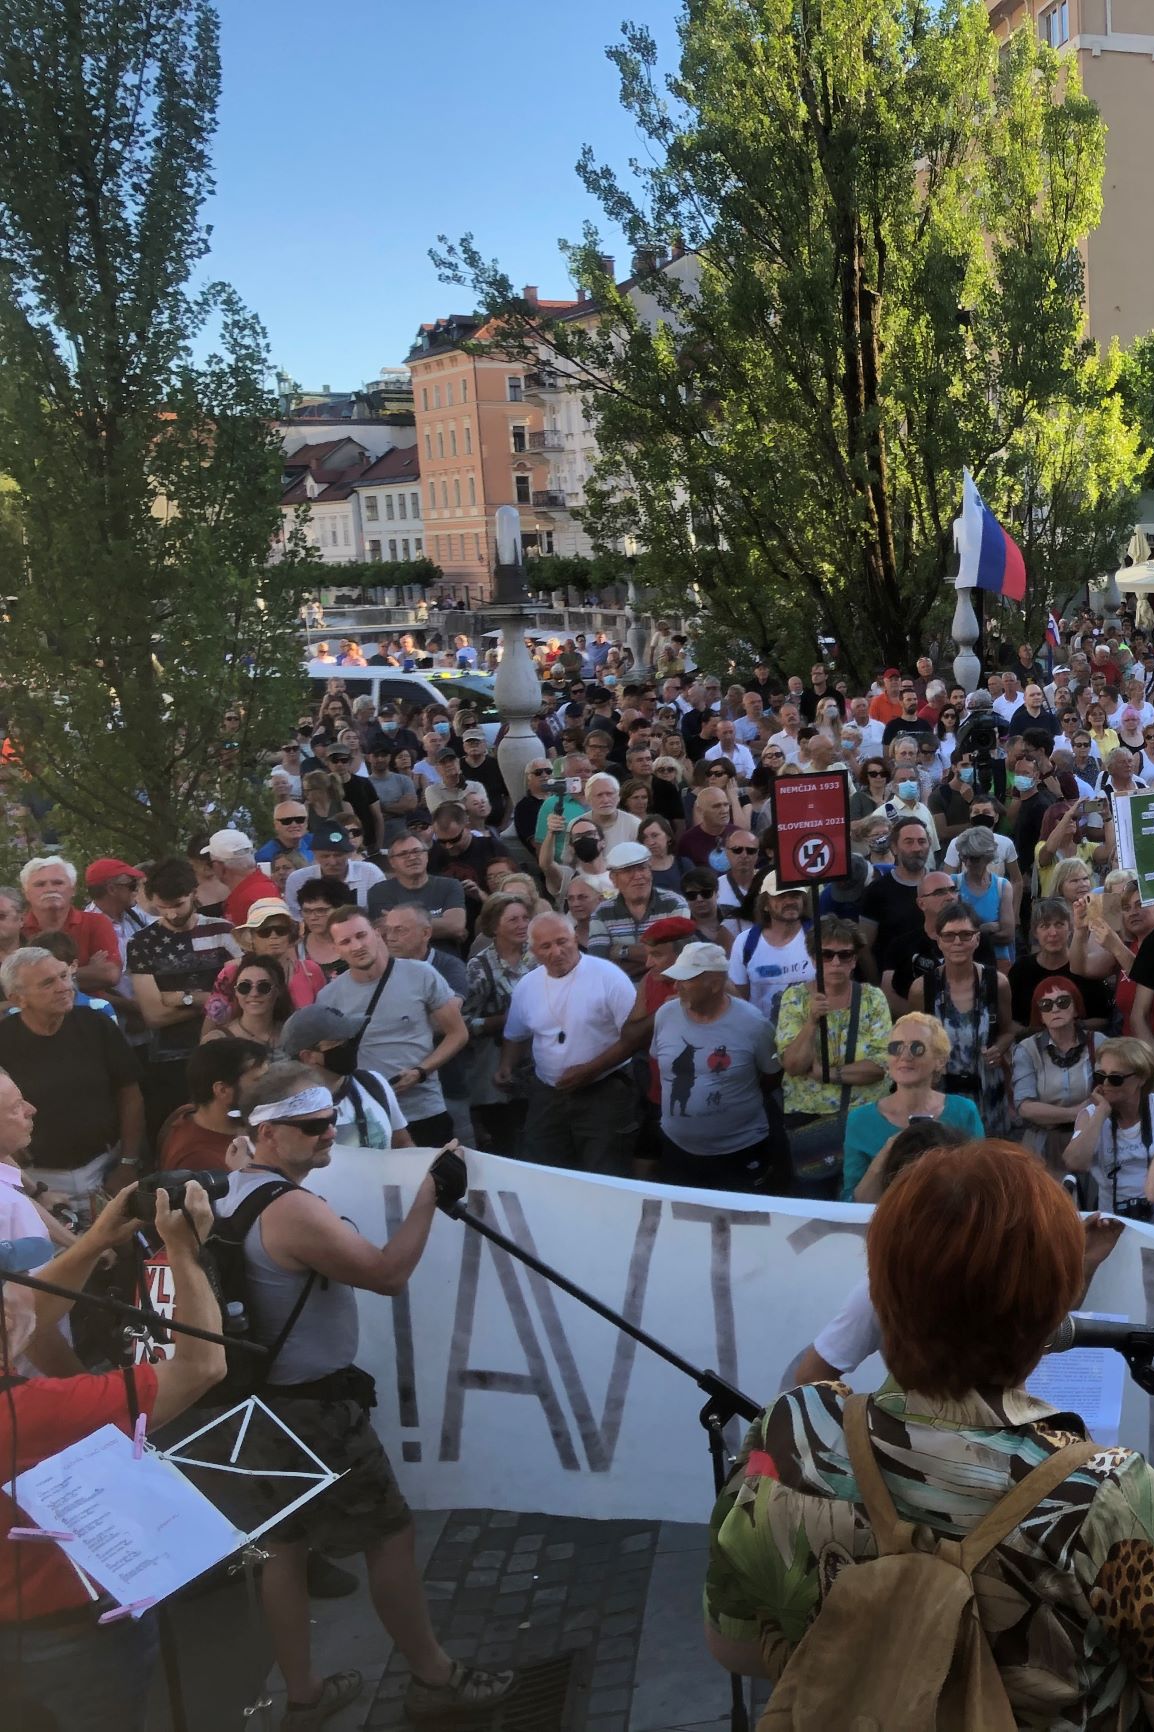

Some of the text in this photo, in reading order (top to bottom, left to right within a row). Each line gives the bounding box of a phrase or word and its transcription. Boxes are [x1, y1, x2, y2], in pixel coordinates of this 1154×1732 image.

[780, 781, 840, 794] NEMČIJA 1933
[777, 817, 846, 832] SLOVENIJA 2021
